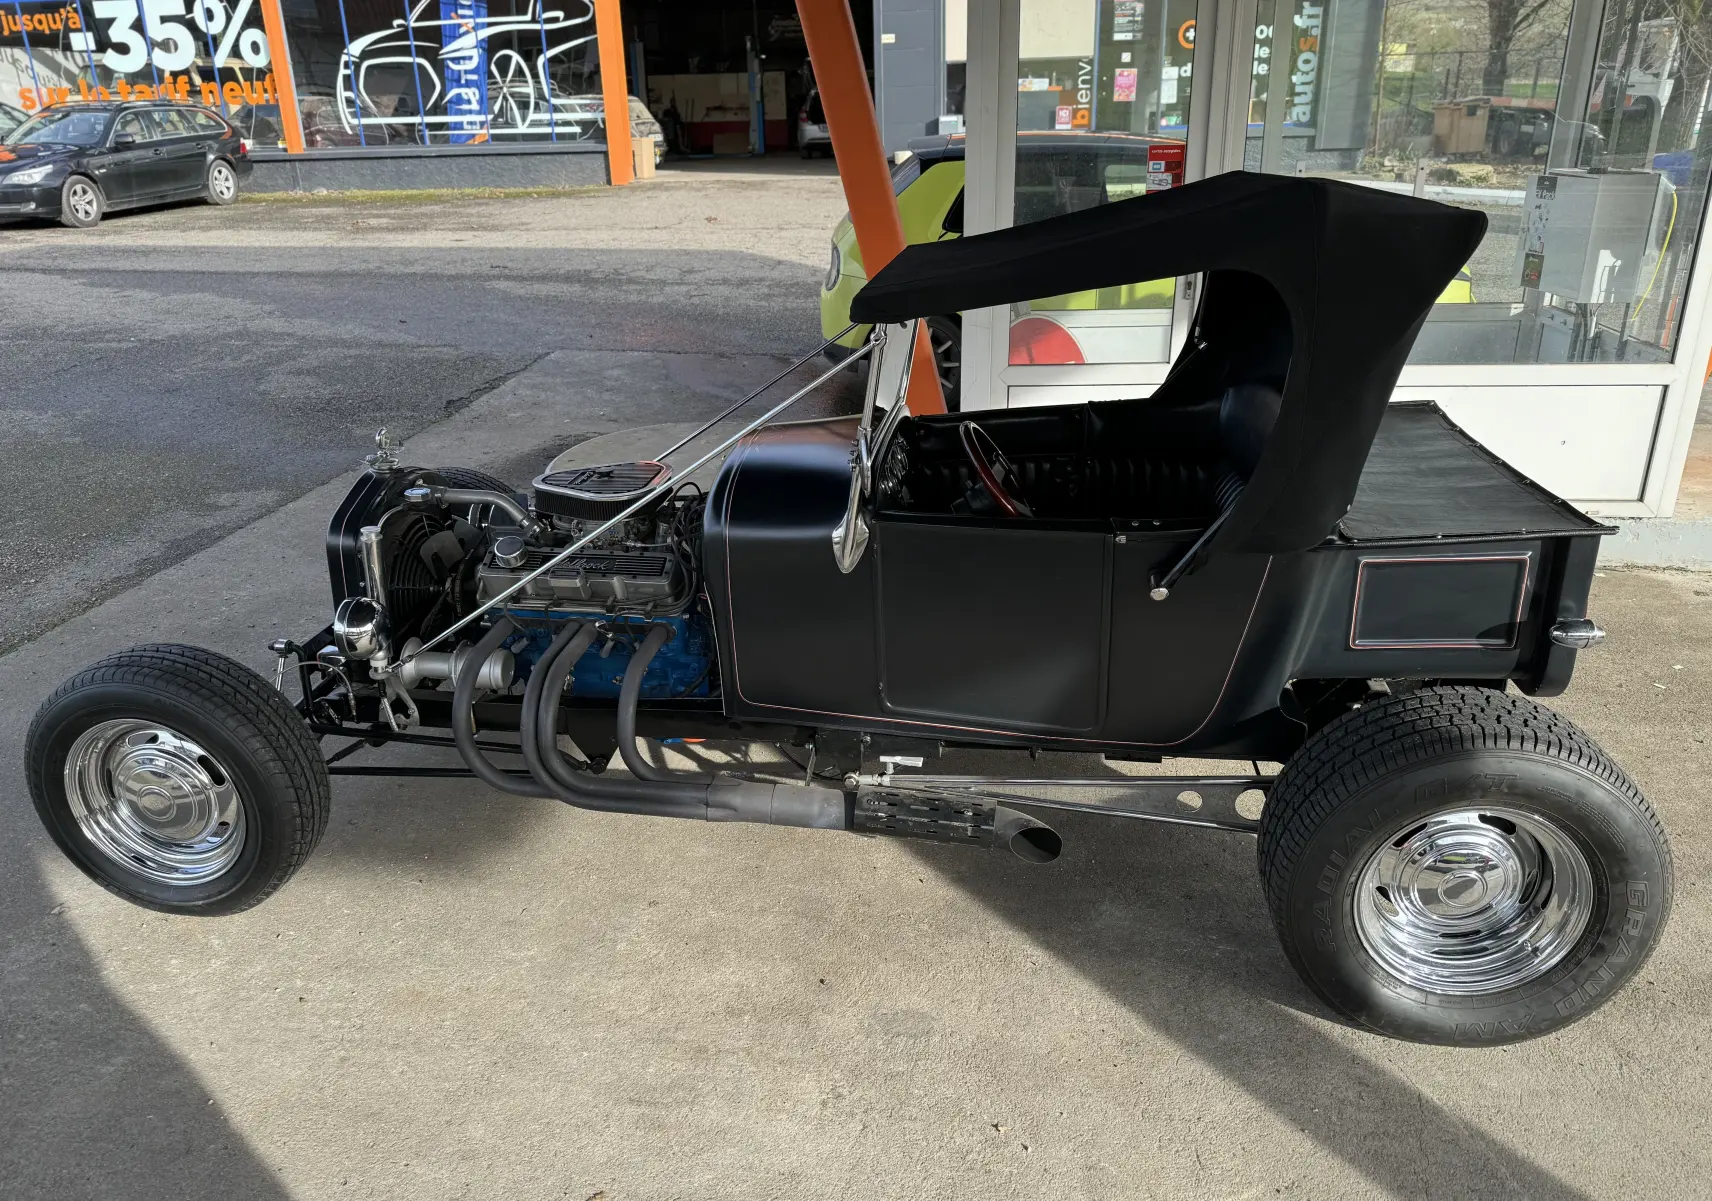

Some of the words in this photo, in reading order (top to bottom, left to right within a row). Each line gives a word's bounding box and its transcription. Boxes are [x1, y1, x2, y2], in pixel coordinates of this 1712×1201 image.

[0, 7, 81, 36] jusqu'à
[19, 87, 69, 110] sur
[117, 75, 190, 104] tarif
[200, 73, 278, 106] neuf
[1291, 1, 1323, 123] autos.fr
[1313, 808, 1399, 951] RADIAL
[1554, 879, 1649, 1017] GRAND
[1452, 1012, 1536, 1040] AM
